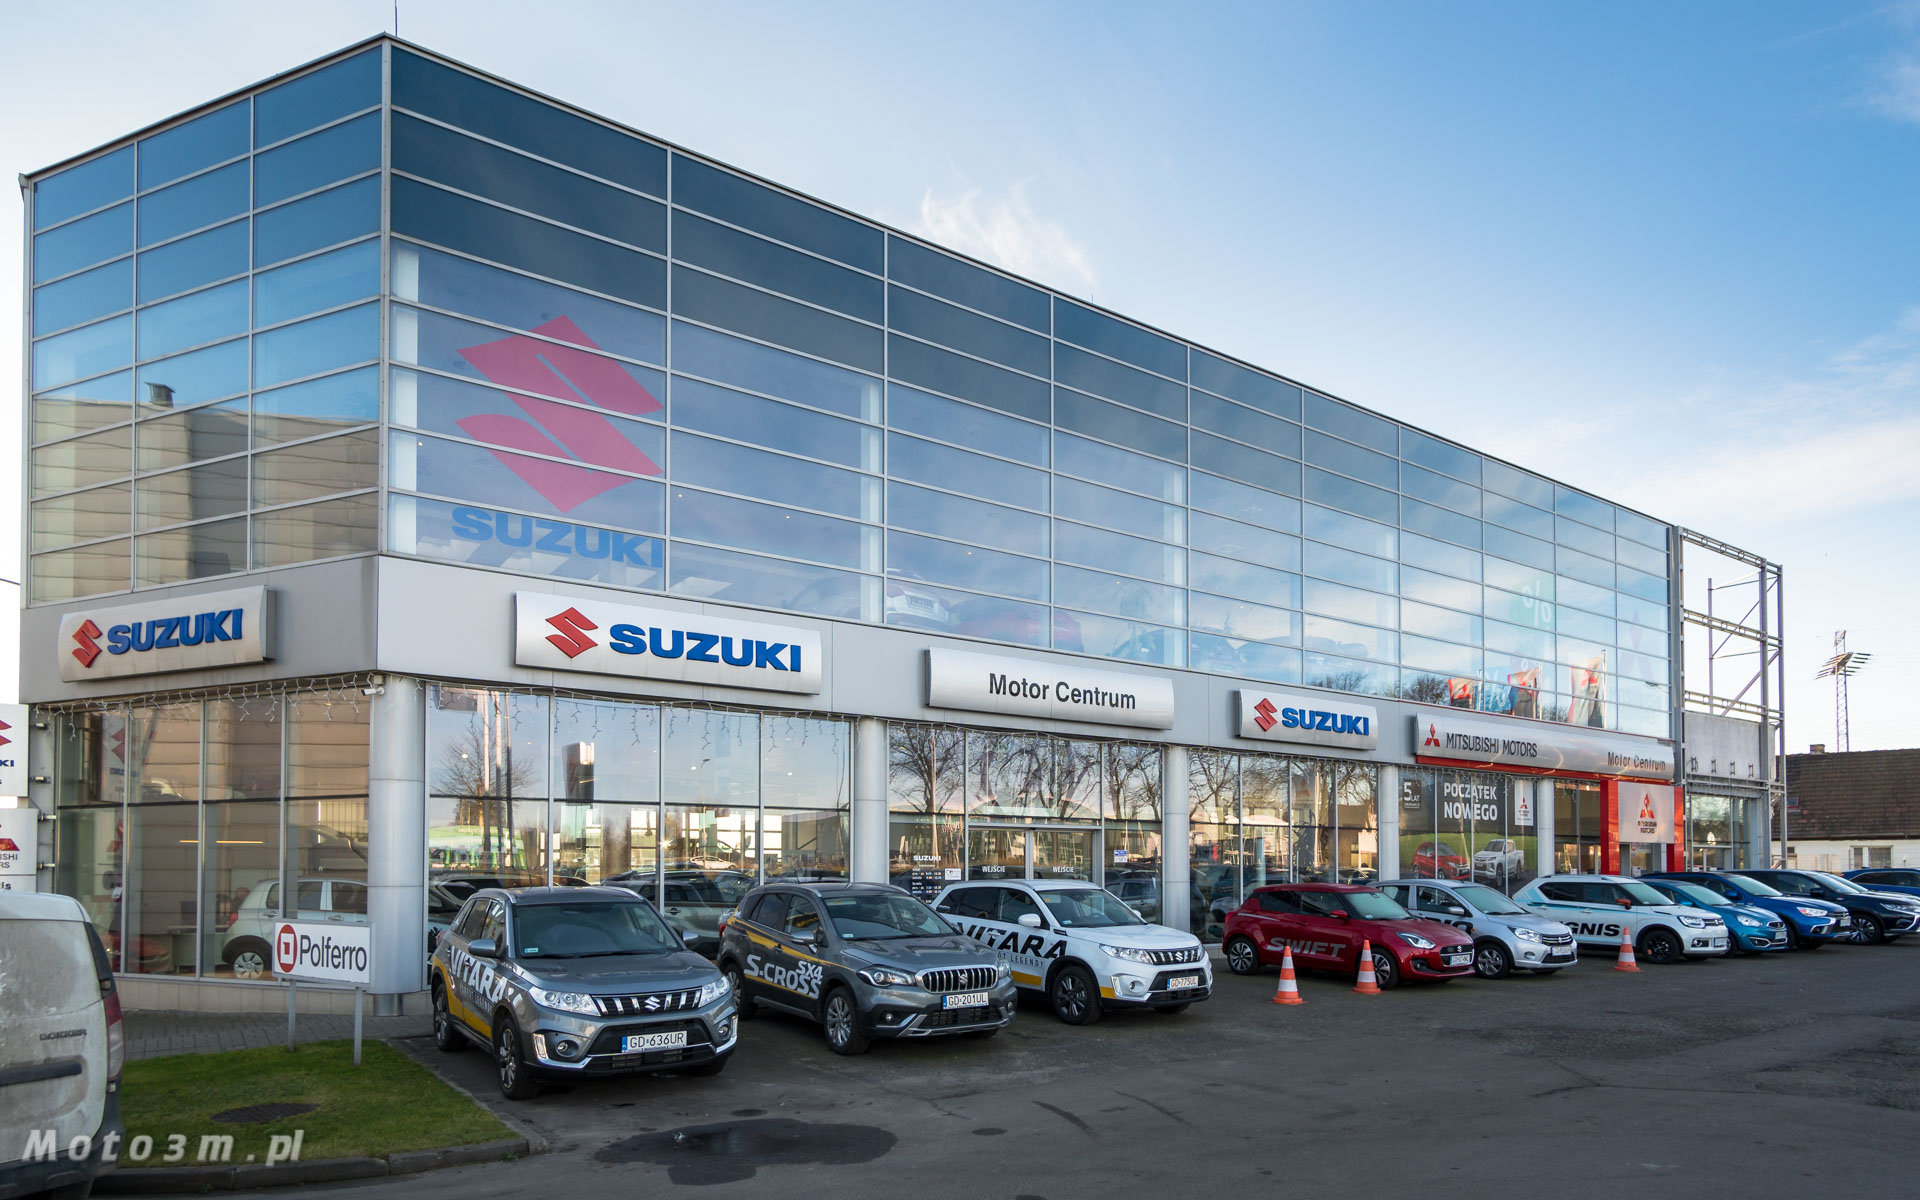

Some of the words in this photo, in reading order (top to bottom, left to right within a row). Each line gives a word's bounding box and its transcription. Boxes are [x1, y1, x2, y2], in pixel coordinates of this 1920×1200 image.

[452, 506, 663, 569] SUZUKI
[107, 607, 243, 656] SUZUKI
[609, 623, 802, 673] SUZUKI
[989, 672, 1050, 700] Motor
[1055, 681, 1136, 710] Centrum
[1281, 706, 1371, 737] SUZUKI
[1446, 732, 1500, 755] MITSUBISHI
[1502, 738, 1538, 758] MOTORS
[1607, 751, 1632, 768] Motor
[1633, 754, 1666, 771] Centrum
[1443, 782, 1498, 802] POCZĄTEK
[1443, 801, 1498, 821] NOWEGO
[981, 865, 1006, 873] WEJŚCIE
[957, 922, 1068, 959] VITARA
[1560, 920, 1621, 937] GNIS
[299, 934, 368, 972] Polferro
[1265, 936, 1347, 958] SWIFT
[448, 945, 509, 1004] VITARA
[795, 960, 824, 981] SX4
[948, 995, 960, 1006] GD
[962, 993, 987, 1005] 201UL
[630, 1036, 646, 1049] GD
[649, 1032, 685, 1047] 636UR
